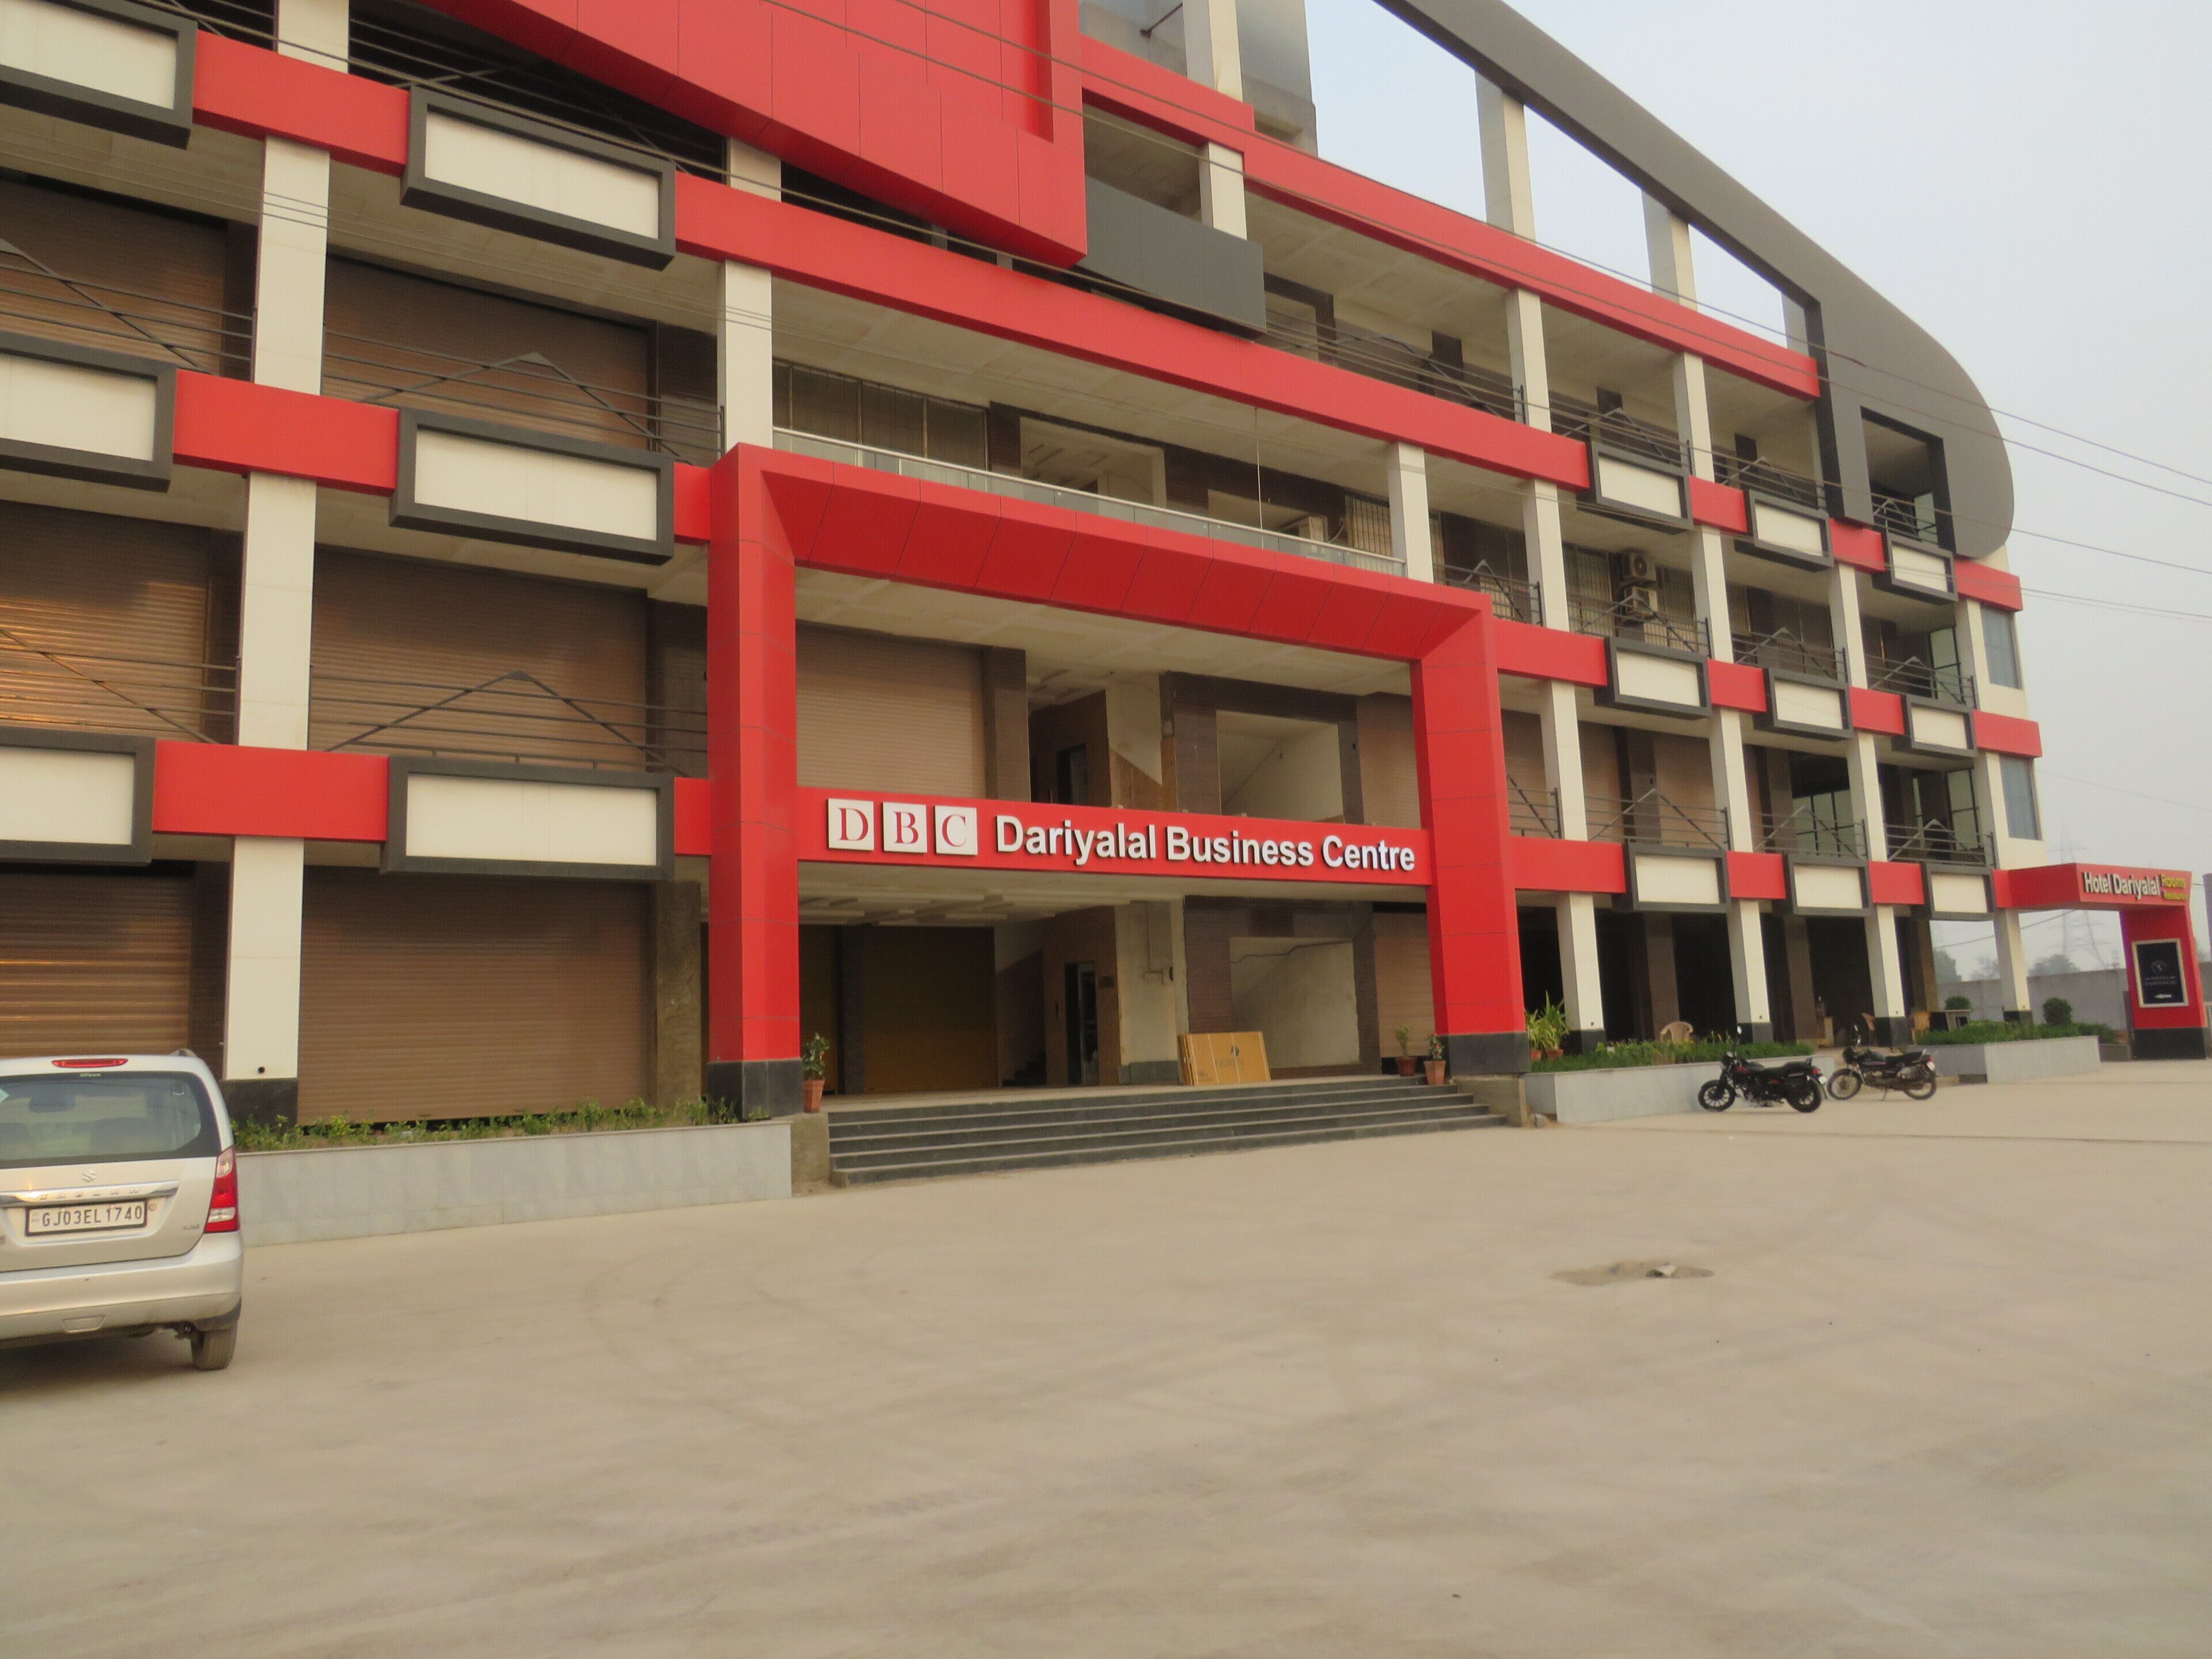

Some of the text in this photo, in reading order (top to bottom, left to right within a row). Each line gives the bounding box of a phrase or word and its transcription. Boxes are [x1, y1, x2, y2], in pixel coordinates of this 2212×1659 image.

[995, 815, 1156, 865] Dariyalal
[1166, 825, 1314, 866] Business
[1322, 835, 1415, 871] Centre
[2083, 872, 2112, 893] Hotel
[2112, 873, 2160, 900] Dariyalal
